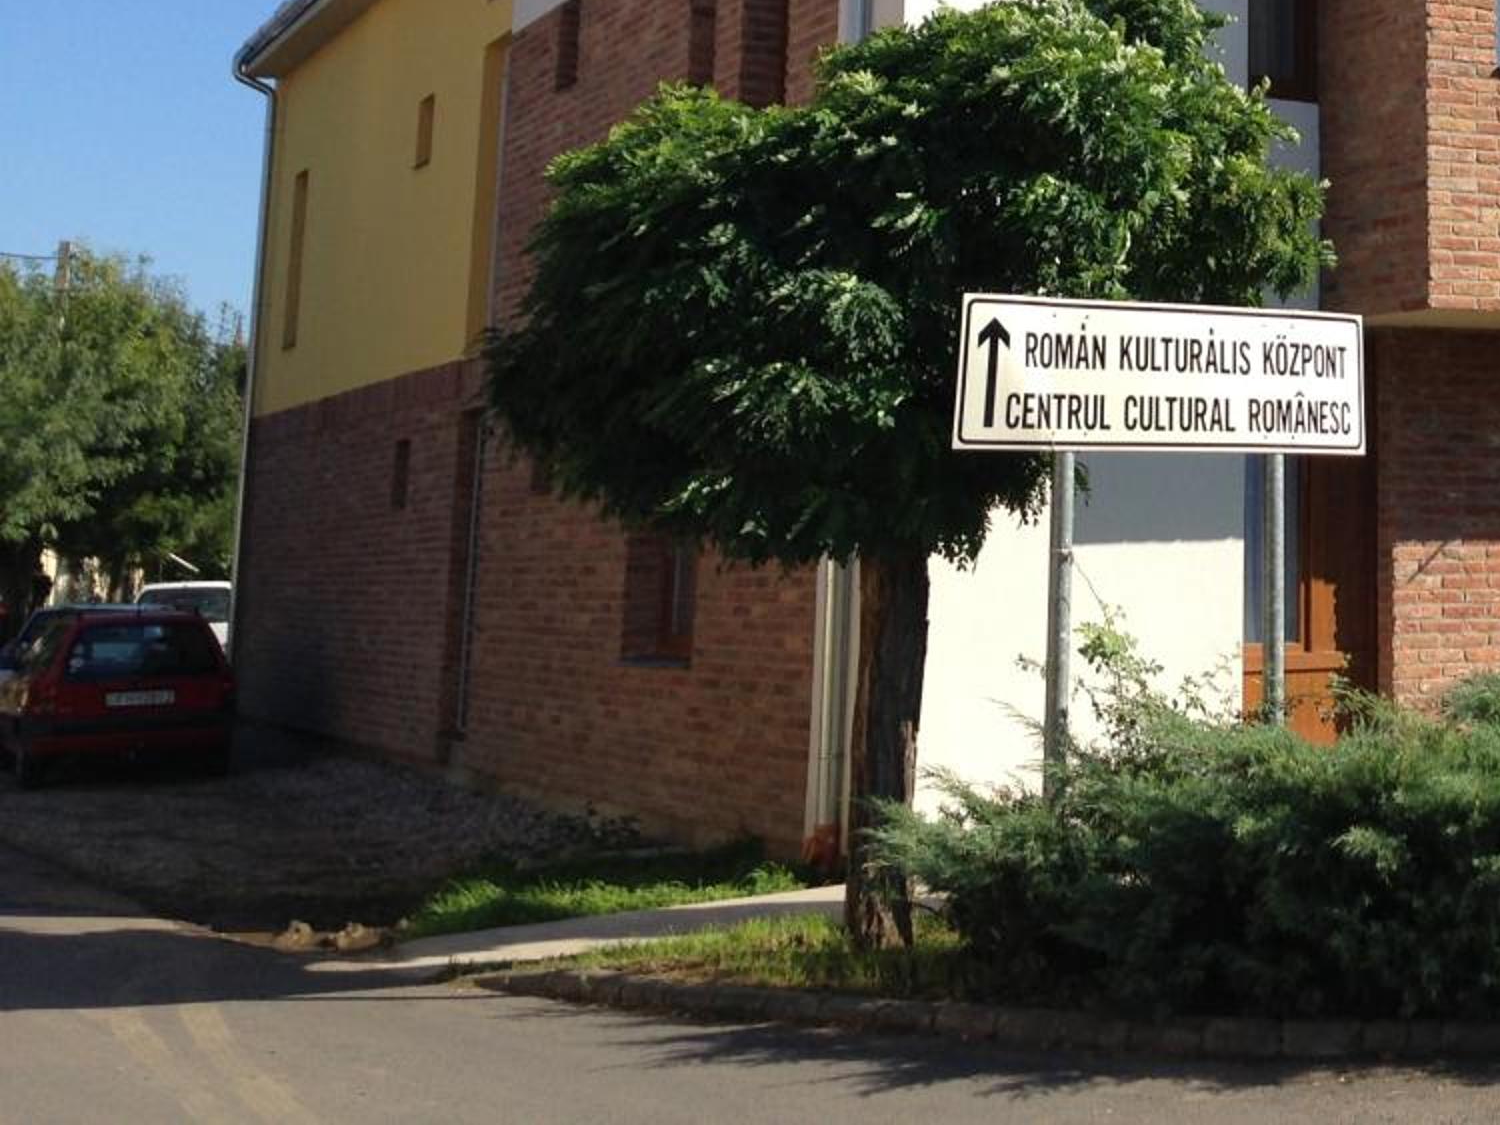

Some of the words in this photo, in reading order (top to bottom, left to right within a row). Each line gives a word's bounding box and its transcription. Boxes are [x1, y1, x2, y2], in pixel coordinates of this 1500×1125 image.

[1025, 322, 1106, 371] ROMÁN
[1119, 327, 1251, 375] KULTURÁLIS
[1263, 334, 1347, 379] KÖZPONT
[1005, 393, 1111, 430] CENTRUL
[1124, 395, 1236, 433] CULTURAL
[1249, 391, 1351, 435] ROMÂNESC
